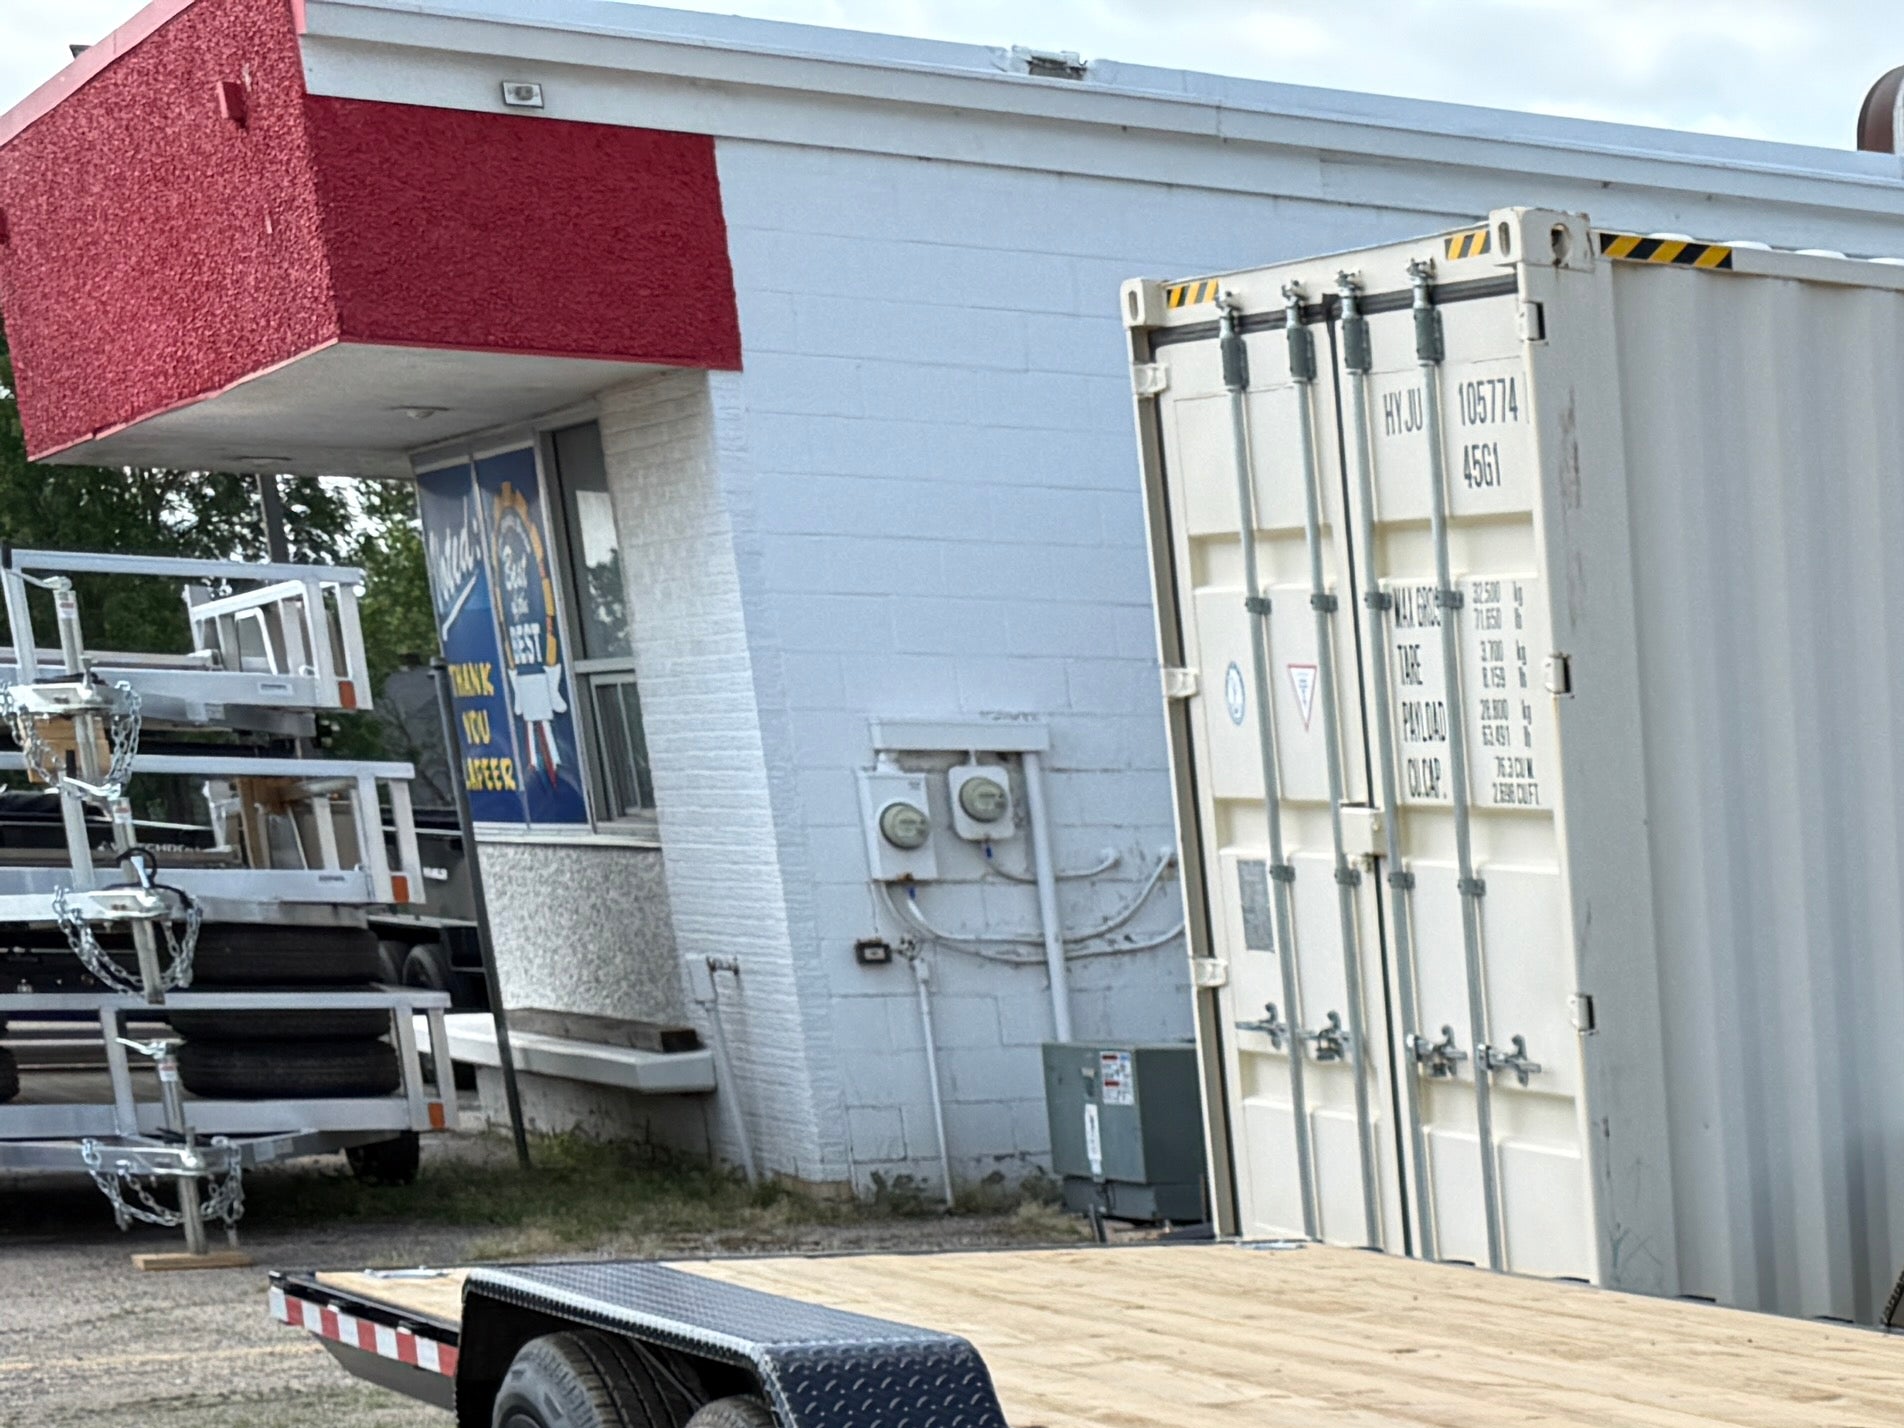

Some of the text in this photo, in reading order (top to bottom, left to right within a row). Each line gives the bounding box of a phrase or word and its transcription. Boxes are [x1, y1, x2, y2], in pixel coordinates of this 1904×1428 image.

[1383, 376, 1519, 436] HYJU 105774
[1463, 442, 1501, 489] 45G1
